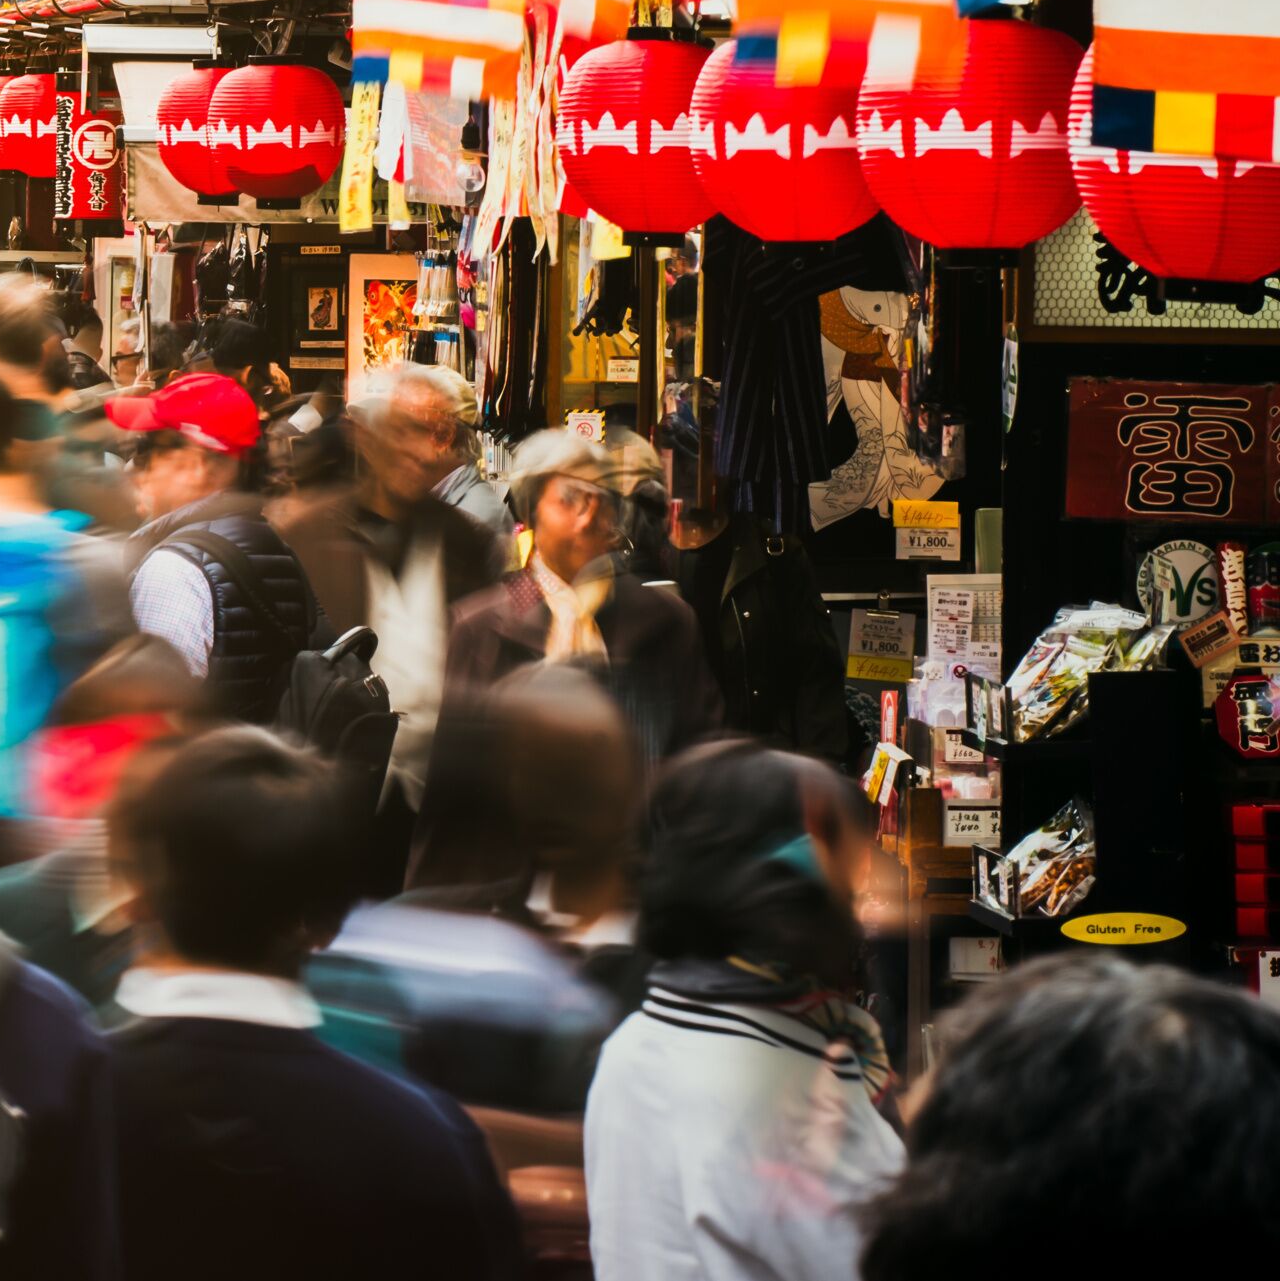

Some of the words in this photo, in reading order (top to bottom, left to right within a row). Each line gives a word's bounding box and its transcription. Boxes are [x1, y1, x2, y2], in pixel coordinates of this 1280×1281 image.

[1118, 392, 1280, 518] 雷
[909, 536, 947, 548] ¥1,800
[861, 640, 899, 652] ¥1,800
[1086, 924, 1125, 934] Gluten
[1134, 924, 1161, 934] Free
